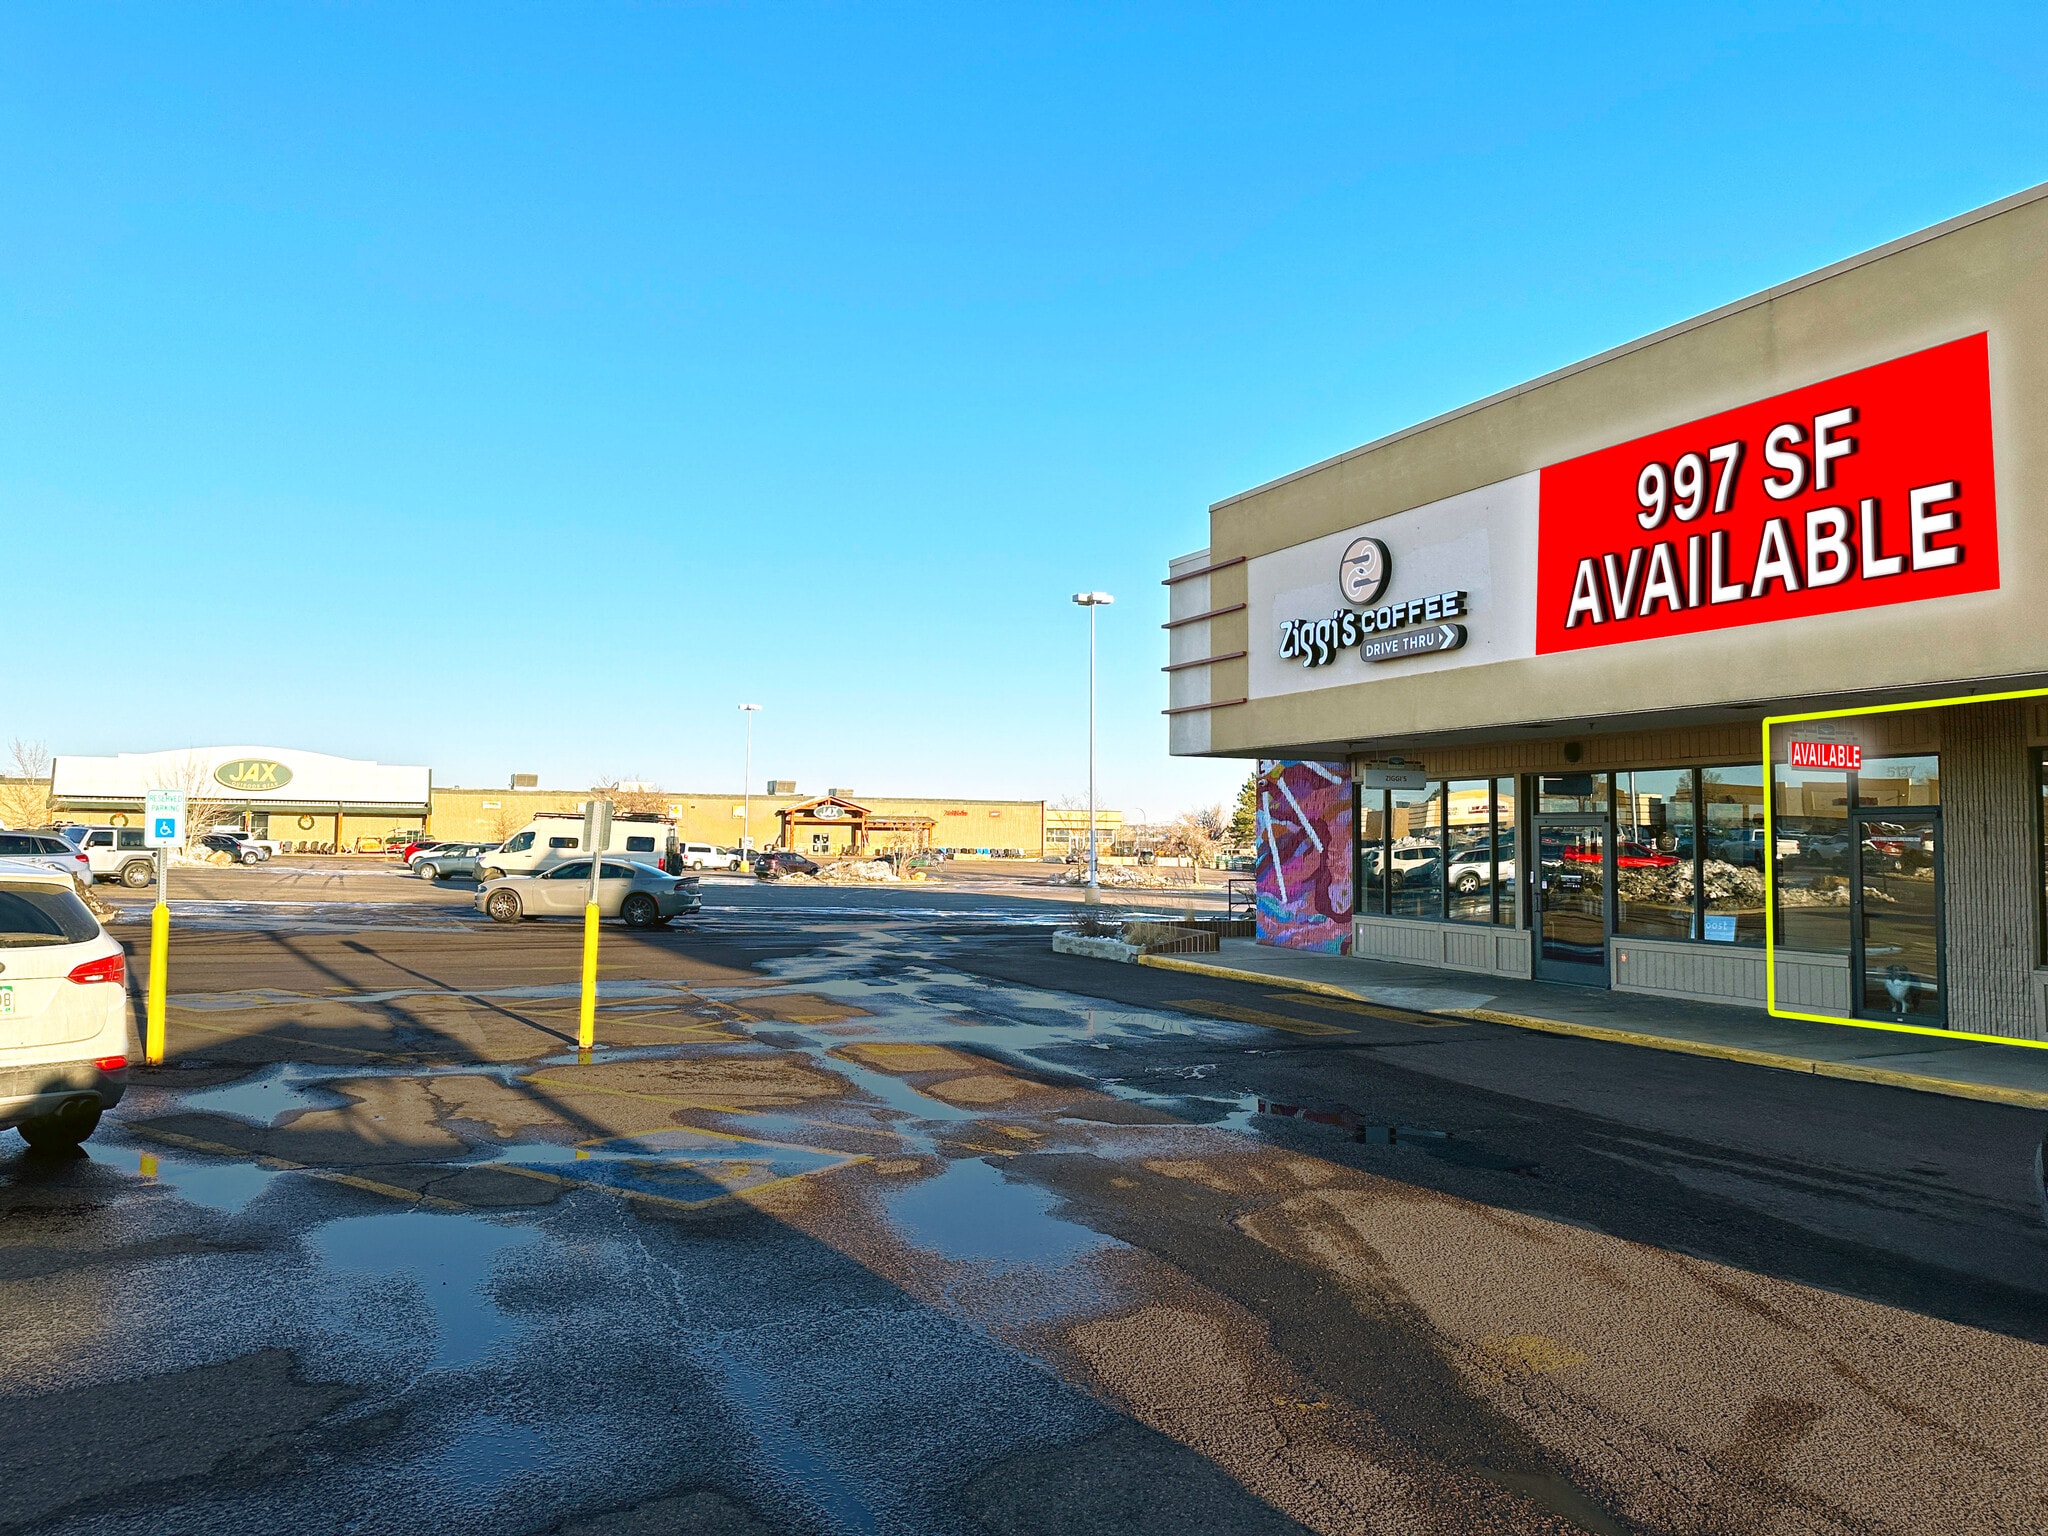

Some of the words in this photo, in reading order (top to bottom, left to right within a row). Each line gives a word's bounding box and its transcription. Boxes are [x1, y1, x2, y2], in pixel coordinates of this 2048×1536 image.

[1279, 607, 1360, 668] Ziggi's
[1361, 590, 1463, 633] COFFEE
[1366, 639, 1399, 657] DRIVE
[1402, 632, 1435, 651] THRU
[229, 762, 278, 782] JAX
[148, 794, 183, 803] RESERVED
[151, 804, 180, 812] PARKING
[820, 806, 839, 818] JAX
